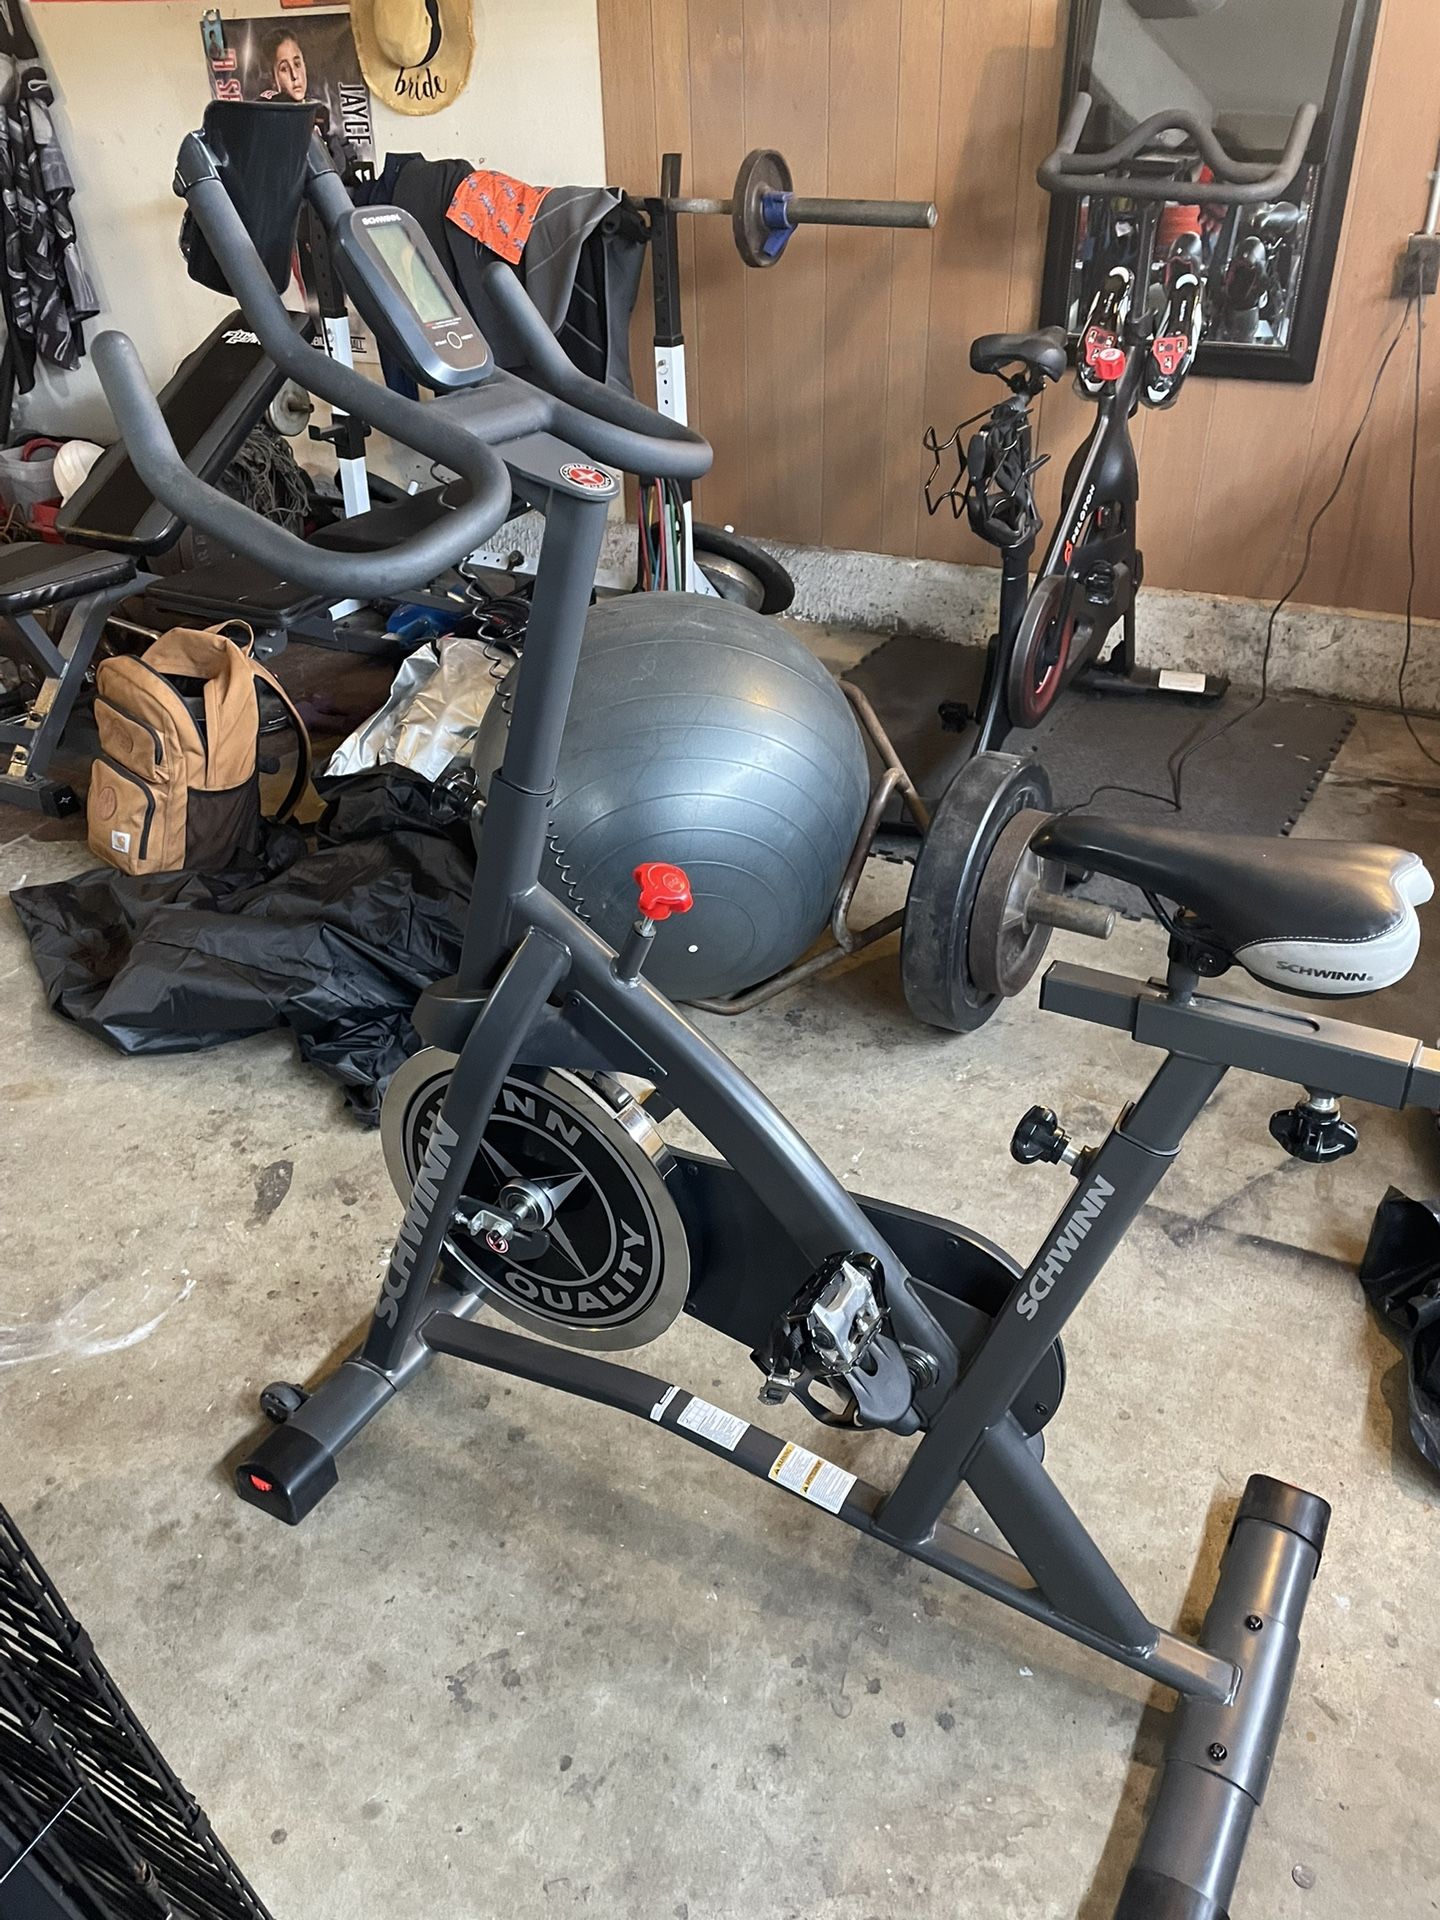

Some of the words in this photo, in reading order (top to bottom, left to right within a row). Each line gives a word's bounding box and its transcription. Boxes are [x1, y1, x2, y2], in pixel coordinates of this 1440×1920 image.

[395, 66, 447, 101] bride
[1071, 484, 1096, 544] PELOTON
[1275, 960, 1367, 982] SCHWINN
[375, 1109, 460, 1330] SCHWINN
[1016, 1174, 1116, 1321] SCHWINN
[505, 1218, 646, 1313] QUALITY
